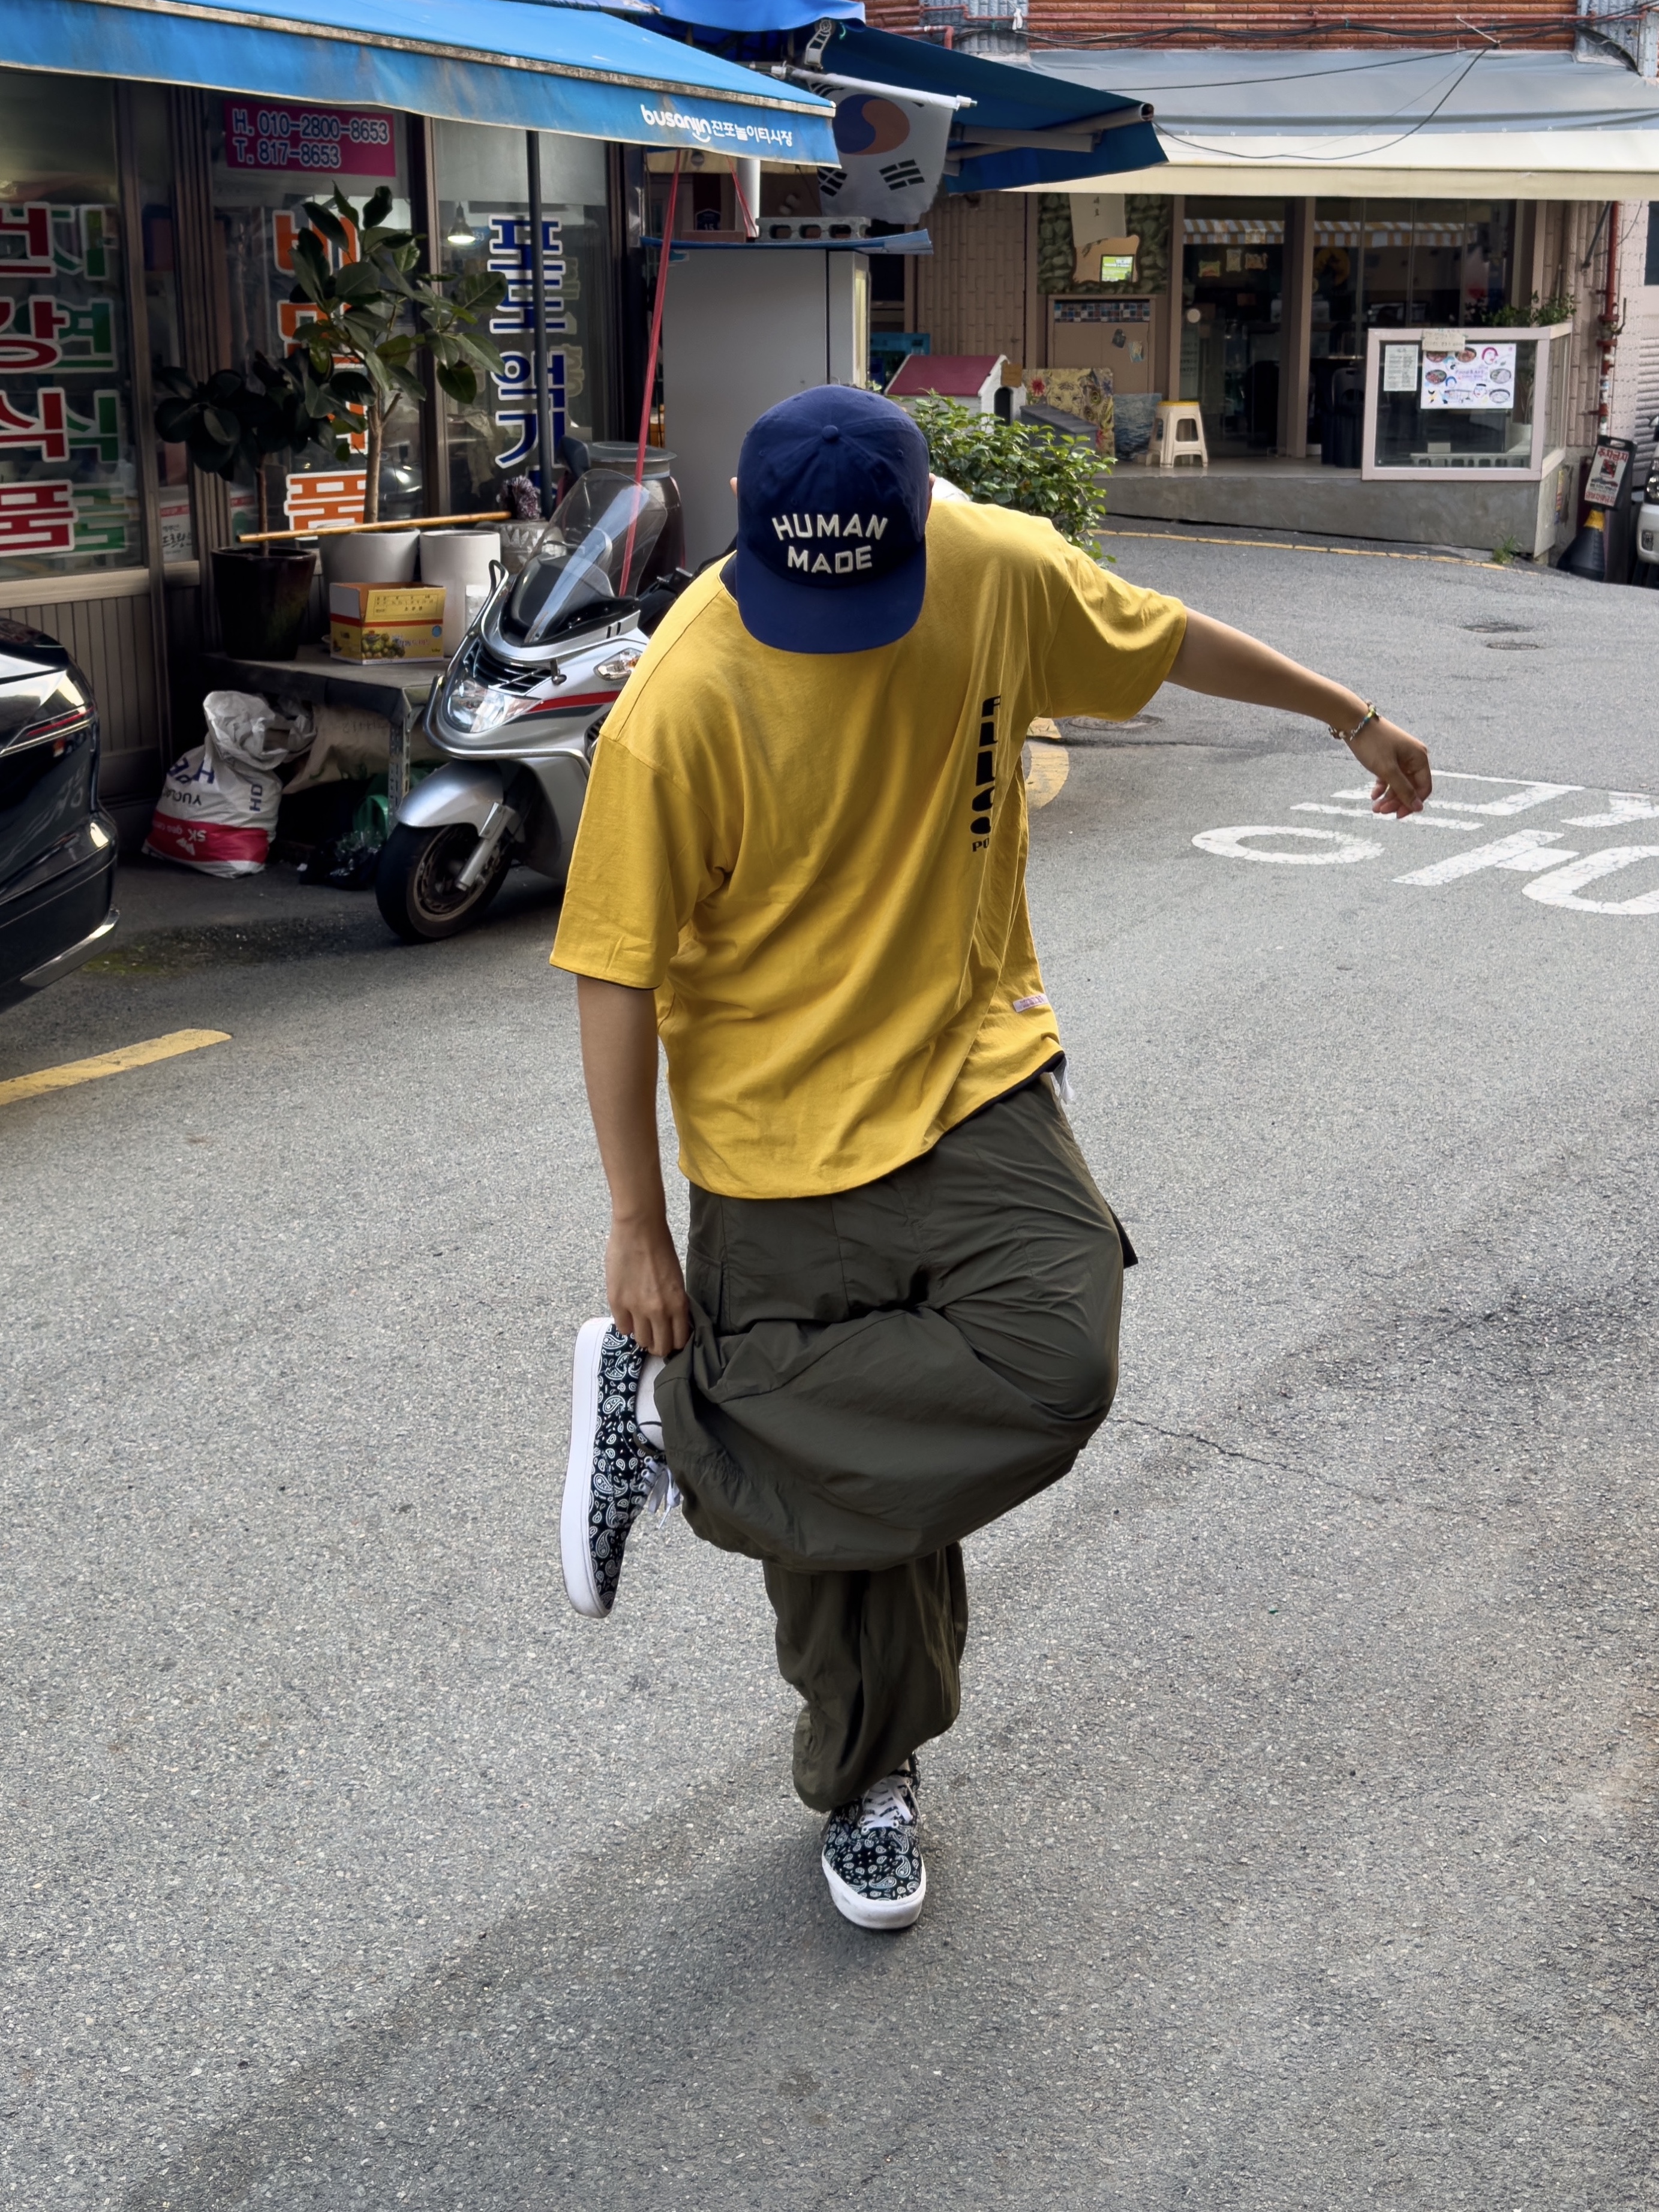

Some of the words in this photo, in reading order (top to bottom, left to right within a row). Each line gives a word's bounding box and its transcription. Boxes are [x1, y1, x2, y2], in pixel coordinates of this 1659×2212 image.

[232, 108, 254, 136] H.
[257, 110, 390, 145] 010-2800-8653
[641, 104, 712, 138] busanjin
[232, 137, 254, 164] T.
[257, 137, 341, 169] 817-8653
[771, 513, 888, 540] HUMAN
[788, 546, 872, 573] MADE
[188, 828, 208, 842] SK
